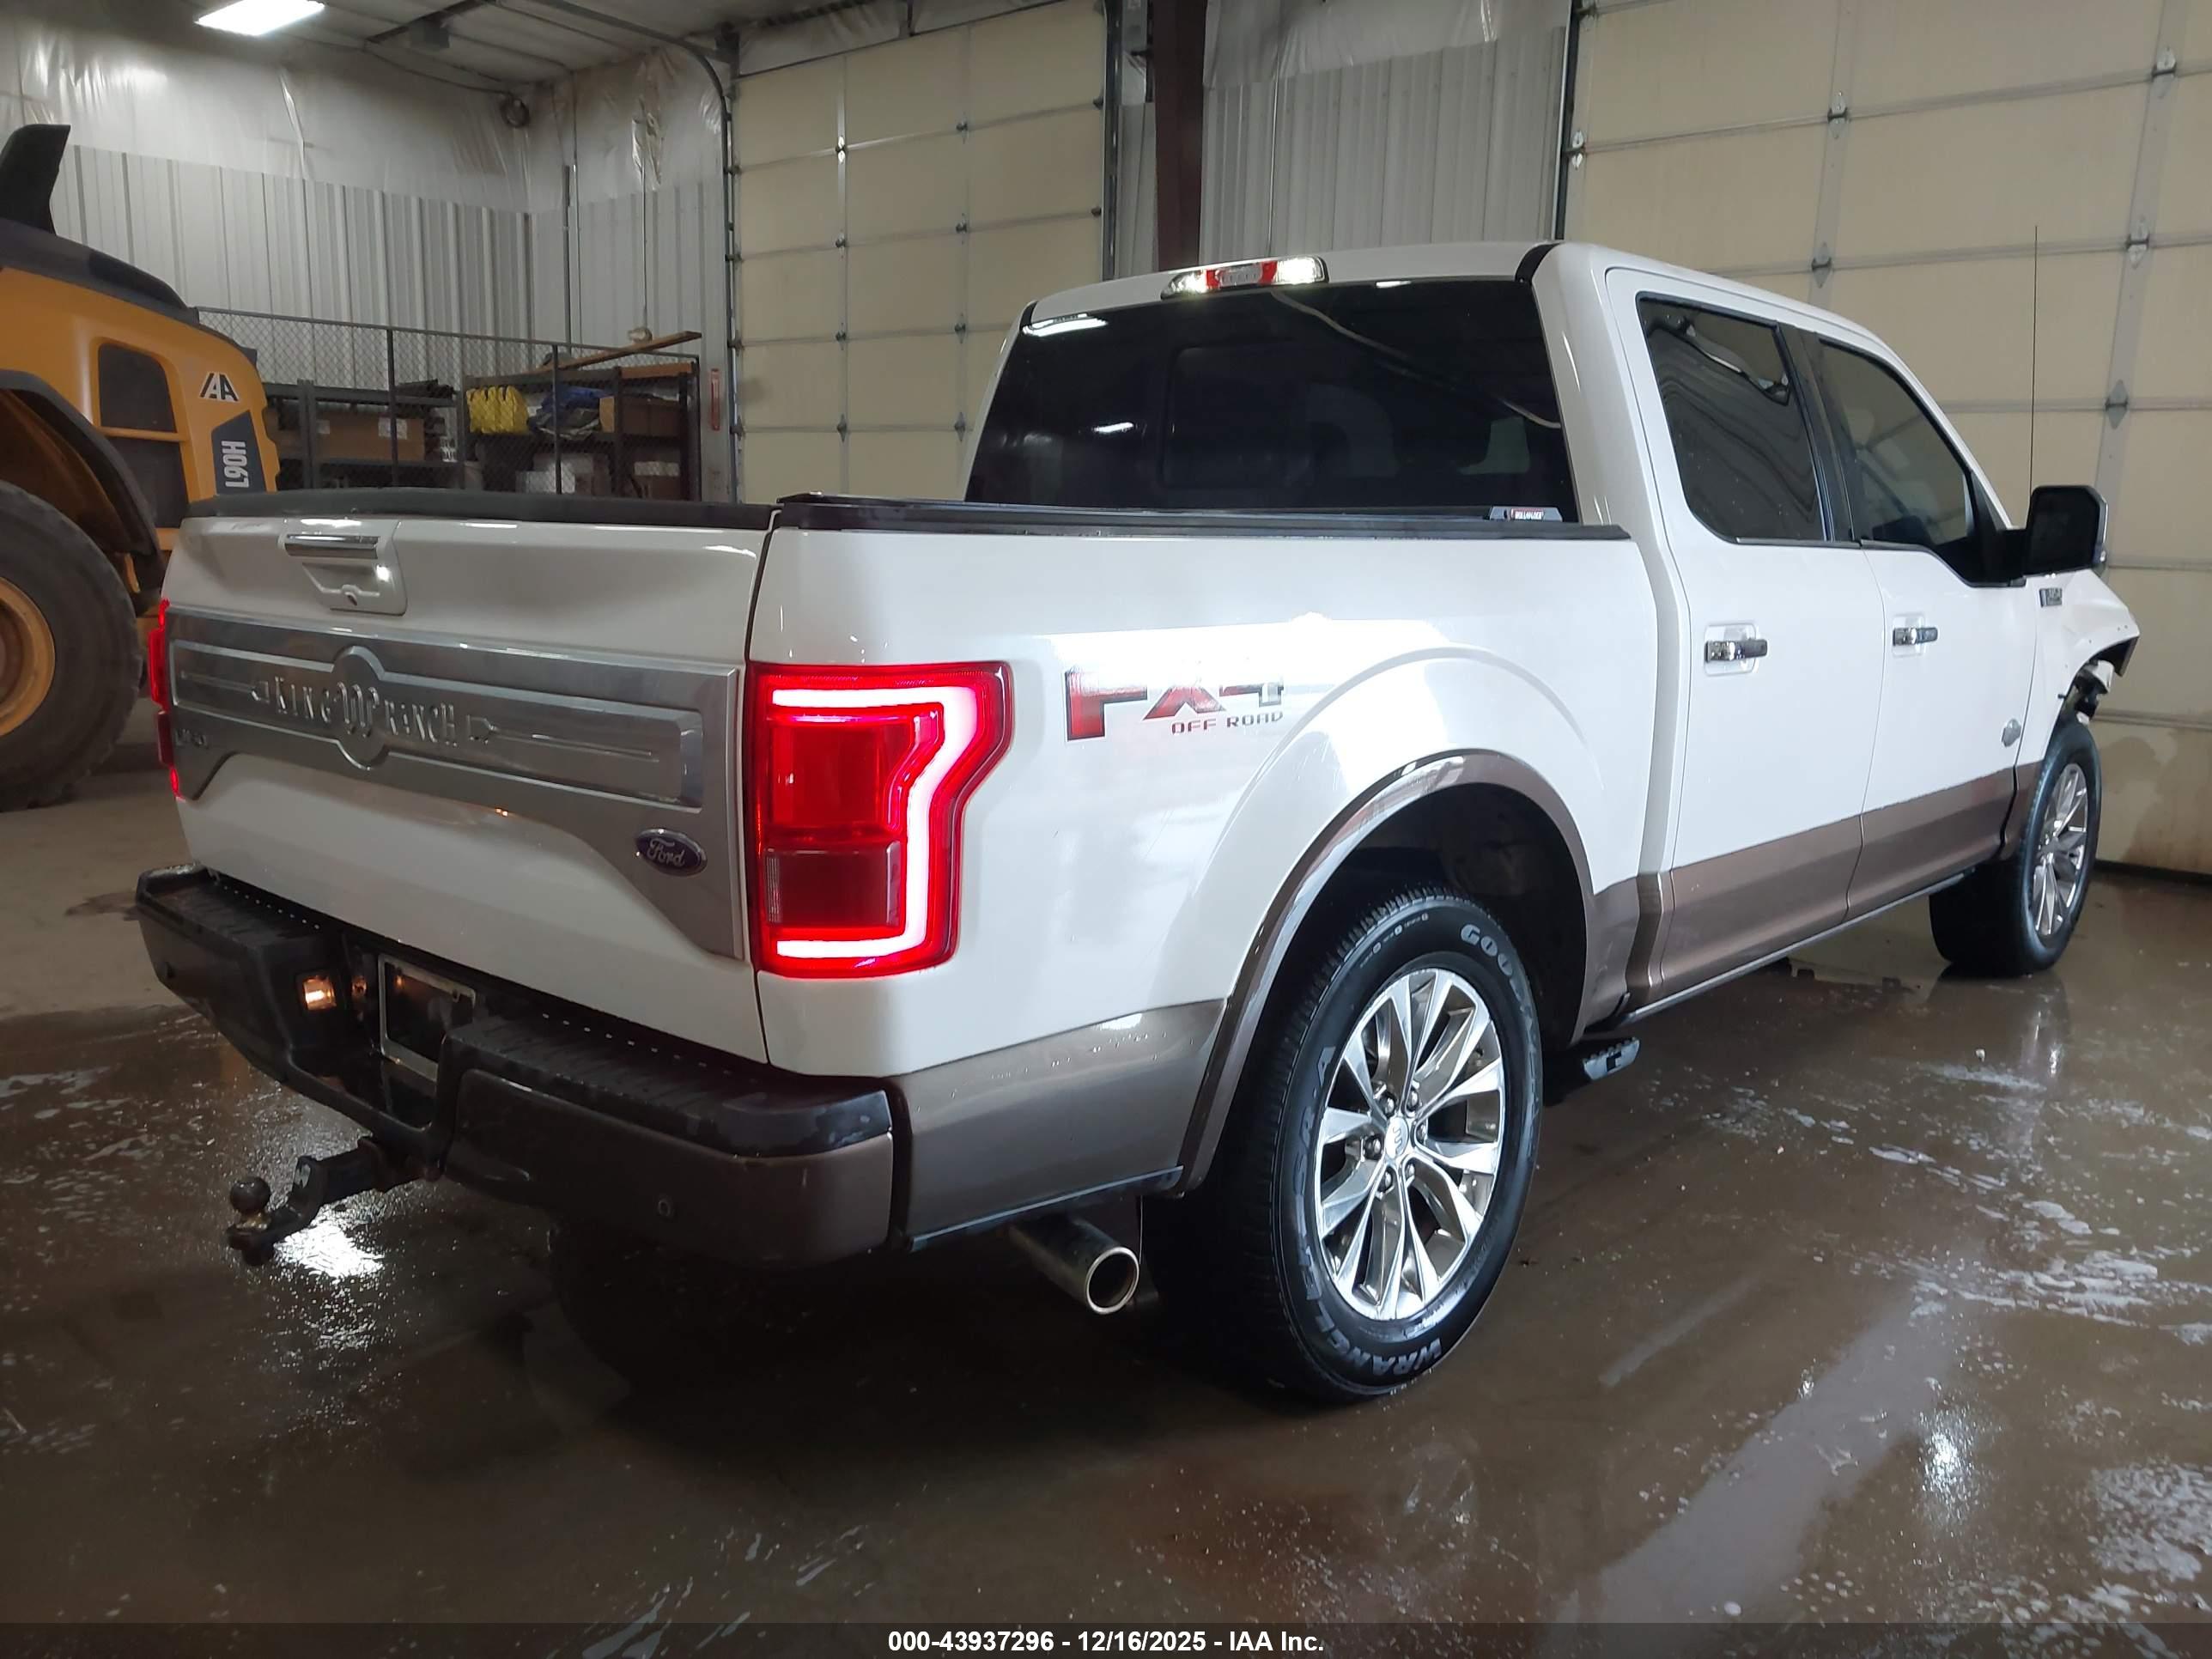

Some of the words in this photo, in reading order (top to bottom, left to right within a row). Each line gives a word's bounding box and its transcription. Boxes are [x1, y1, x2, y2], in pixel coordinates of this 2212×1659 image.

[221, 440, 250, 488] L90H
[1171, 718, 1217, 735] OFF
[1226, 710, 1285, 728] ROAD
[647, 837, 686, 867] Ford
